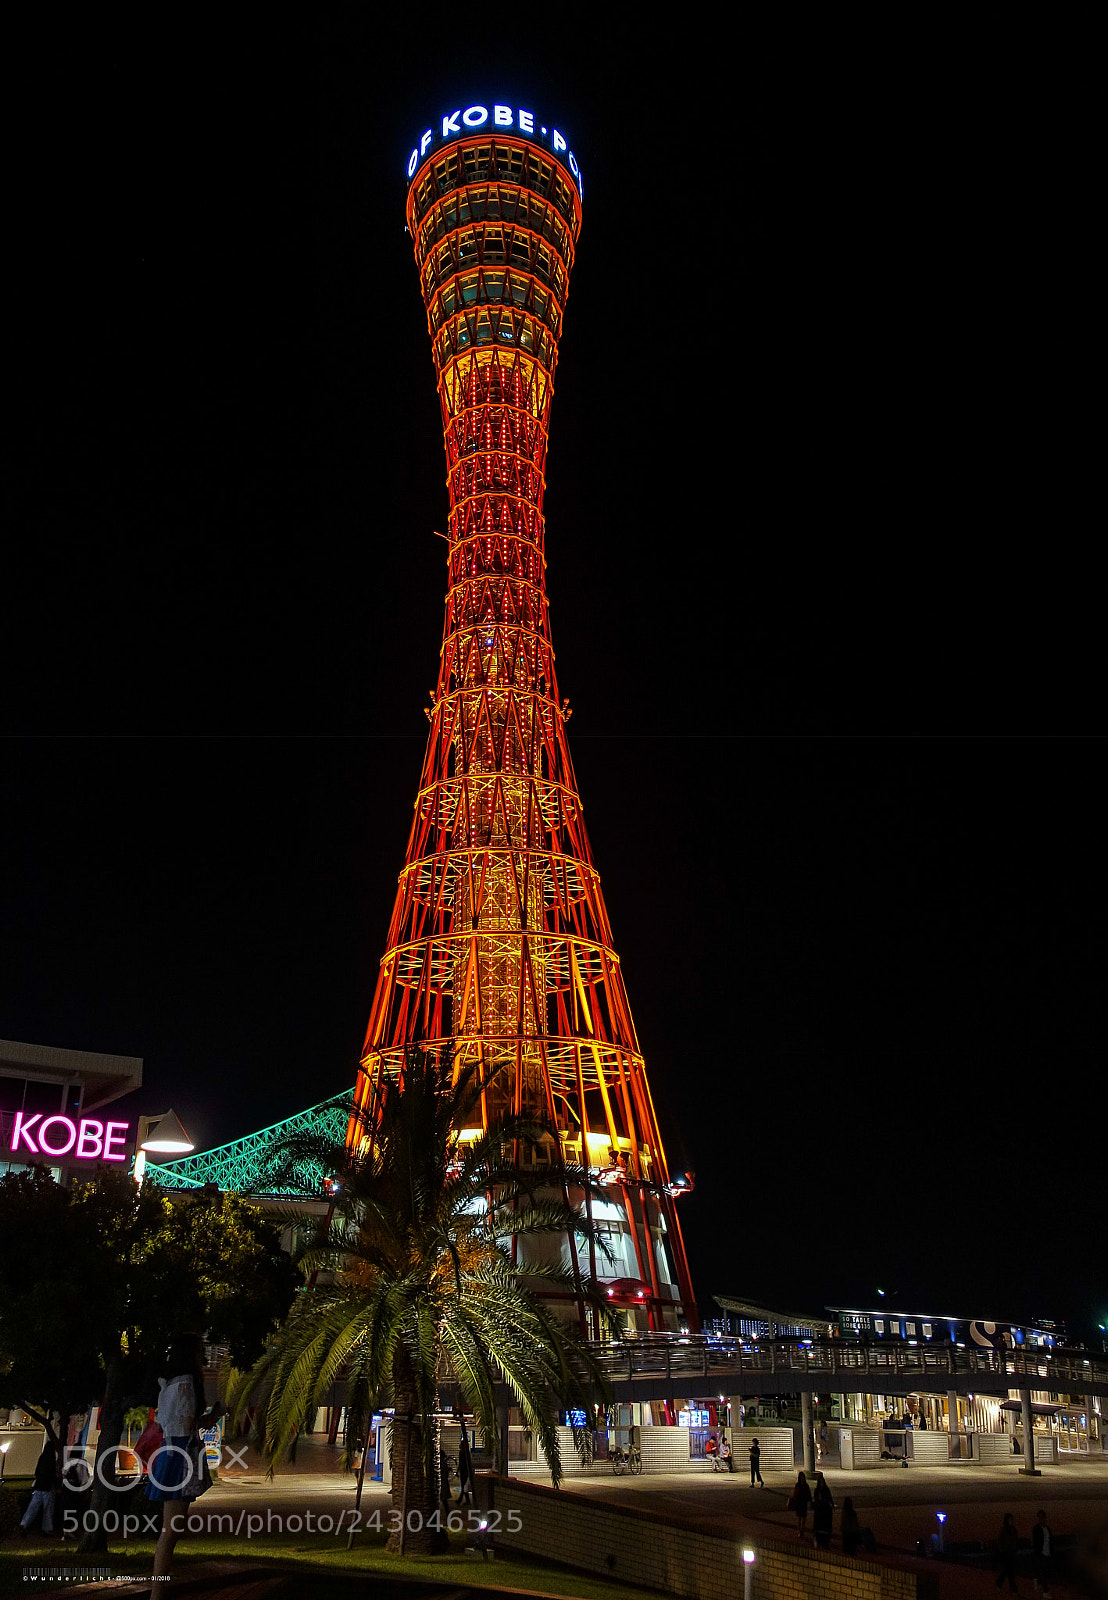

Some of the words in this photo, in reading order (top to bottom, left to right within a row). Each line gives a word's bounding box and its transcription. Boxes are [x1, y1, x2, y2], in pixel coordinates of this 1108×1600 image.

[407, 129, 433, 178] OF
[442, 104, 535, 137] KOBE
[10, 1111, 129, 1161] KOBE
